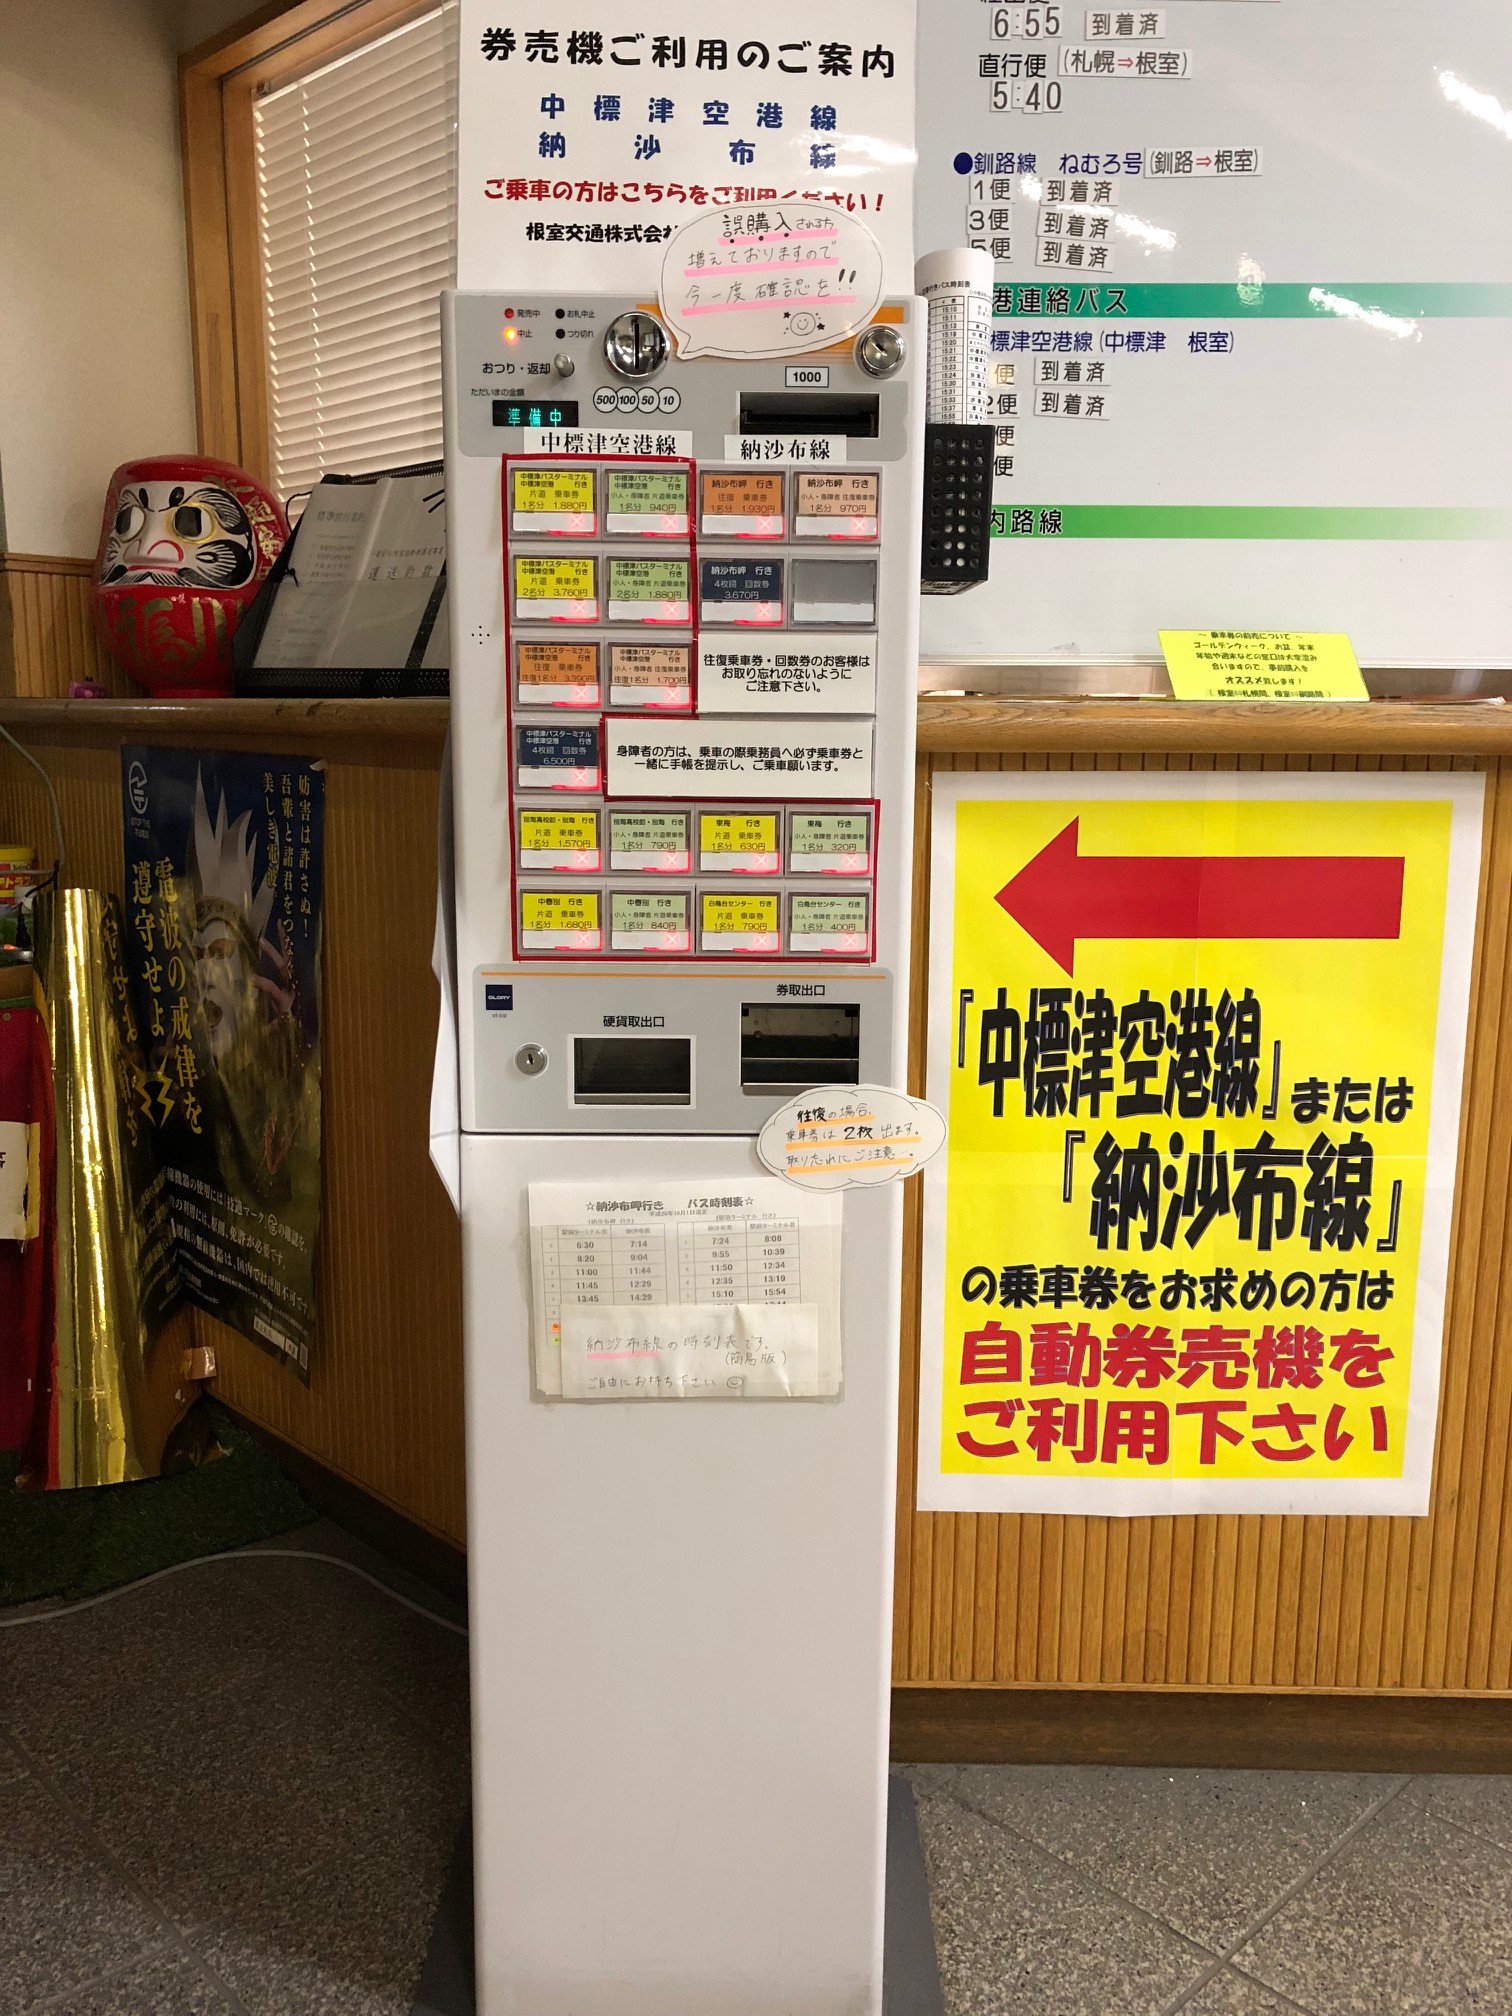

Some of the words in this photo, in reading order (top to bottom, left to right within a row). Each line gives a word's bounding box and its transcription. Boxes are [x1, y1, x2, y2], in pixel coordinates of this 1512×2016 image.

[1091, 12, 1159, 36] 到着済
[480, 27, 895, 79] 券売機ご利用のご案内
[978, 54, 1046, 78] 直行便
[992, 81, 1062, 111] 5:40
[540, 93, 837, 130] 中標津空港線
[538, 132, 836, 169] 納沙布線
[973, 152, 1036, 175] 釧路線
[1059, 152, 1142, 175] ねむろ号
[973, 179, 1010, 201] 1便
[1047, 180, 1113, 203] 到着済
[969, 208, 1010, 231] 3便
[1043, 212, 1109, 238] 到着済
[689, 241, 837, 268] 増えておりますので
[1043, 242, 1108, 268] 到着済
[517, 309, 541, 318] 発売中
[567, 309, 595, 319] お札中止
[517, 329, 532, 339] 中止
[567, 329, 594, 339] つり切れ
[482, 362, 551, 376] おつり・返却
[1040, 361, 1106, 385] 到着済
[792, 371, 822, 383] 1000
[470, 388, 525, 397] ただいまの金額
[596, 394, 616, 406] 500
[619, 395, 636, 406] 100
[641, 395, 655, 406] 50
[662, 396, 674, 406] 10
[1040, 392, 1106, 416] 到着済
[507, 407, 563, 427] 準備中
[541, 431, 677, 455] 中標津空港線
[740, 440, 831, 460] 納沙布線
[712, 480, 747, 488] 納沙布岬
[756, 480, 773, 488] 行き
[808, 479, 842, 488] 納沙布岬
[852, 479, 869, 488] 行き
[620, 503, 641, 511] 1名分
[650, 503, 676, 511] 940円
[711, 504, 732, 512] 1名分
[810, 504, 831, 512] 1名分
[840, 504, 866, 512] 970円
[711, 566, 746, 575] 納沙布岬
[755, 566, 772, 575] 行き
[523, 588, 545, 596] 2名分
[617, 590, 639, 598] 2名分
[704, 654, 870, 667] 往復乗車券・回数券のお客様は
[722, 668, 851, 679] お取り忘れのないように
[746, 680, 821, 693] ご注意下さい。
[616, 745, 863, 759] 身障者の方は、乗車の際乗務員へ必ず乗車券と
[635, 759, 840, 772] 一緒に手帳を提示し、ご乗車願います。
[837, 820, 851, 828] 行き
[528, 839, 549, 847] 1名分
[622, 841, 642, 849] 1名分
[651, 842, 676, 850] 790円
[712, 842, 732, 850] 1名分
[740, 843, 765, 851] 630円
[802, 843, 823, 851] 1名分
[831, 843, 856, 851] 320円
[623, 921, 643, 929] 1名分
[742, 923, 767, 931] 790円
[802, 923, 823, 931] 1名分
[831, 923, 855, 931] 400円
[132, 862, 166, 1038] 遵守せよ
[154, 856, 204, 1135] 電波の戒律を
[776, 984, 825, 996] 券取出口
[603, 1016, 665, 1028] 硬貨取出口
[1064, 1129, 1402, 1252] 『納沙布線』
[961, 1263, 1394, 1311] の乗車券をお求めの方は
[959, 1321, 1394, 1389] 自動券売機を
[956, 1397, 1388, 1466] ご利用下さい
